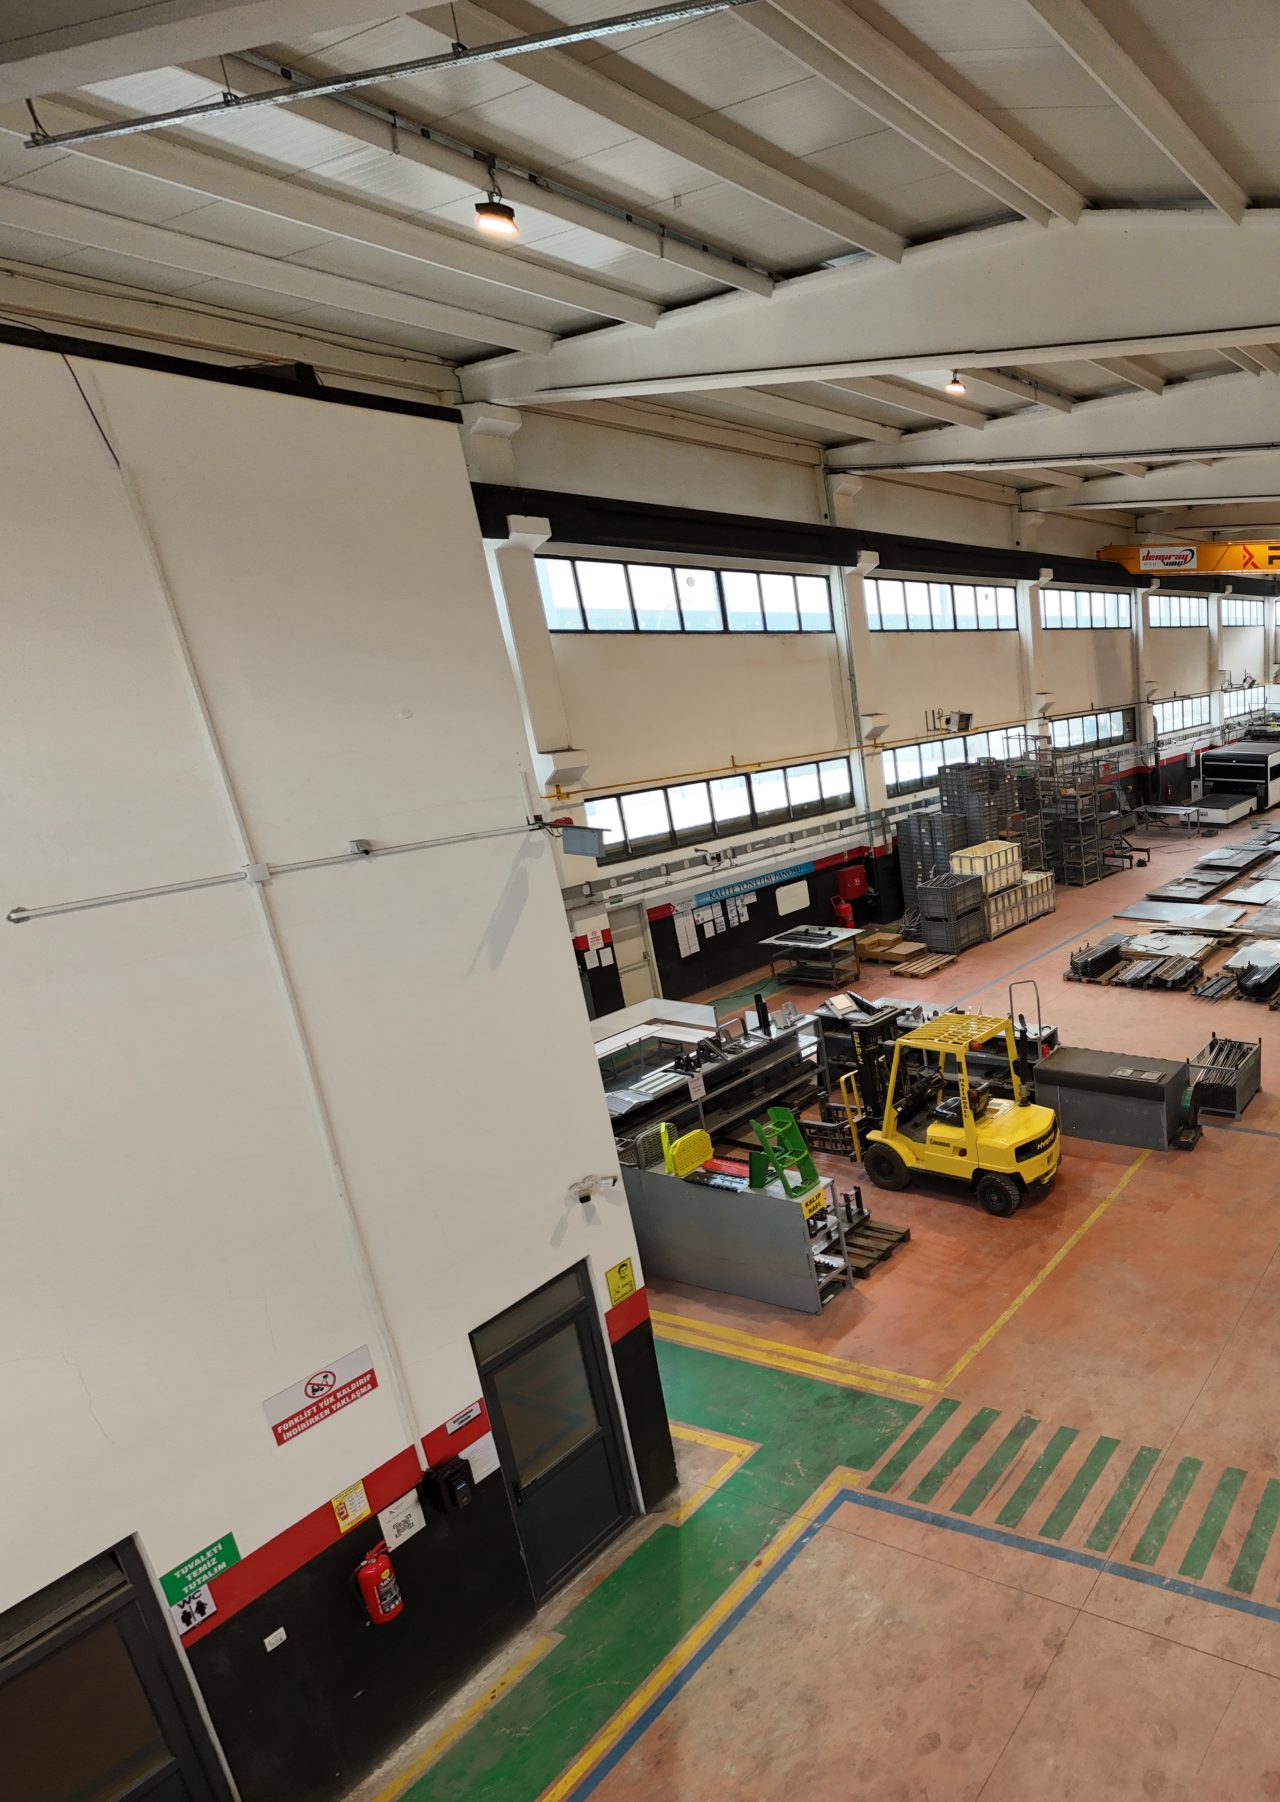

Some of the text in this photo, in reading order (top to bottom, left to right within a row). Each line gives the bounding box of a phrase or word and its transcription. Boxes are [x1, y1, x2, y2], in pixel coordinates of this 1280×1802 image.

[852, 1031, 864, 1065] HYSTER
[318, 1397, 336, 1409] YÜK
[336, 1373, 372, 1399] KALDIRIP
[331, 1383, 373, 1411] YAKLAŞMA
[181, 1561, 227, 1594] TUTALIM
[176, 1589, 203, 1610] WC
